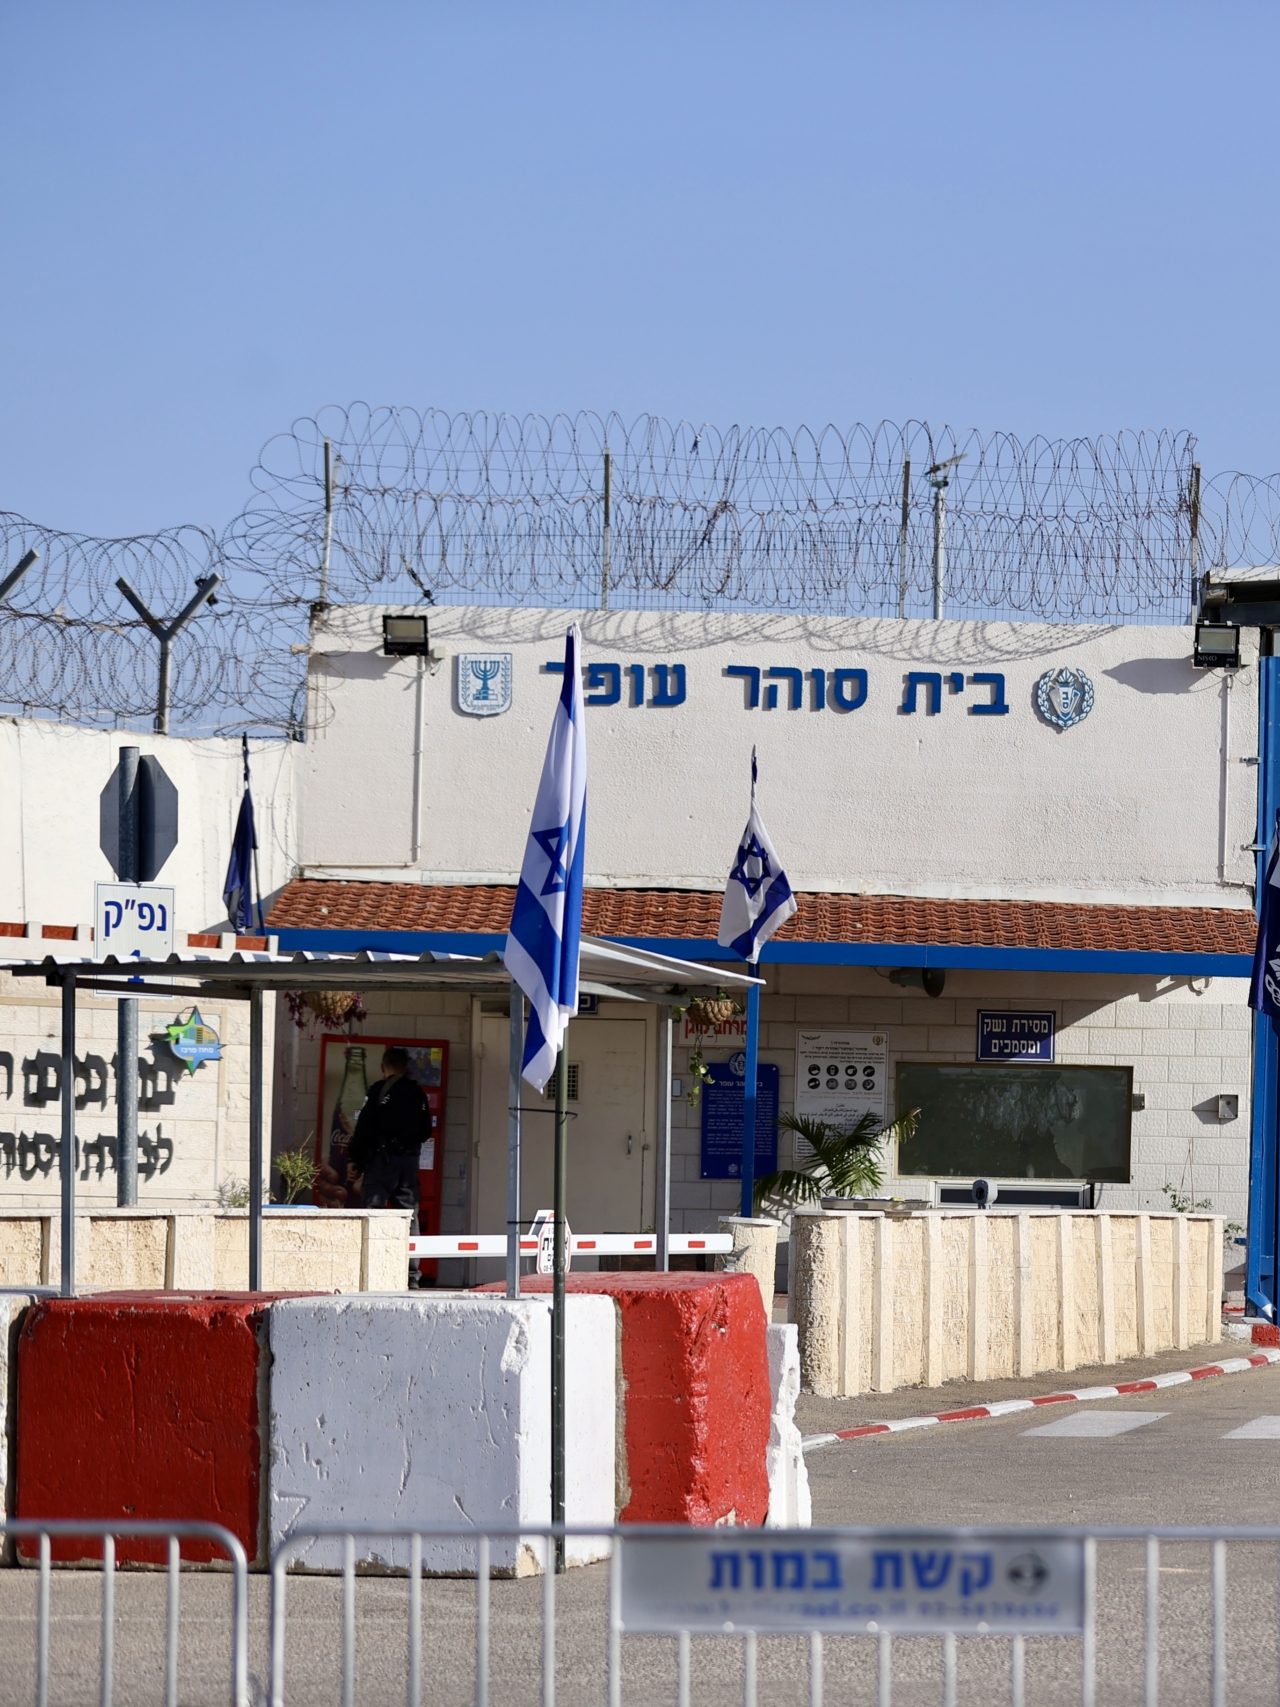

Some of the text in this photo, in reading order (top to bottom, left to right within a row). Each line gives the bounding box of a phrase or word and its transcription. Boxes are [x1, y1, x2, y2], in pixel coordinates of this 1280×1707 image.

[546, 661, 1010, 715] בית סוהר עופ
[104, 899, 167, 937] נפ"ק
[984, 1018, 1049, 1035] מסירת נשק
[991, 1039, 1040, 1054] ומסמכים
[710, 1549, 995, 1598] קשת במות
